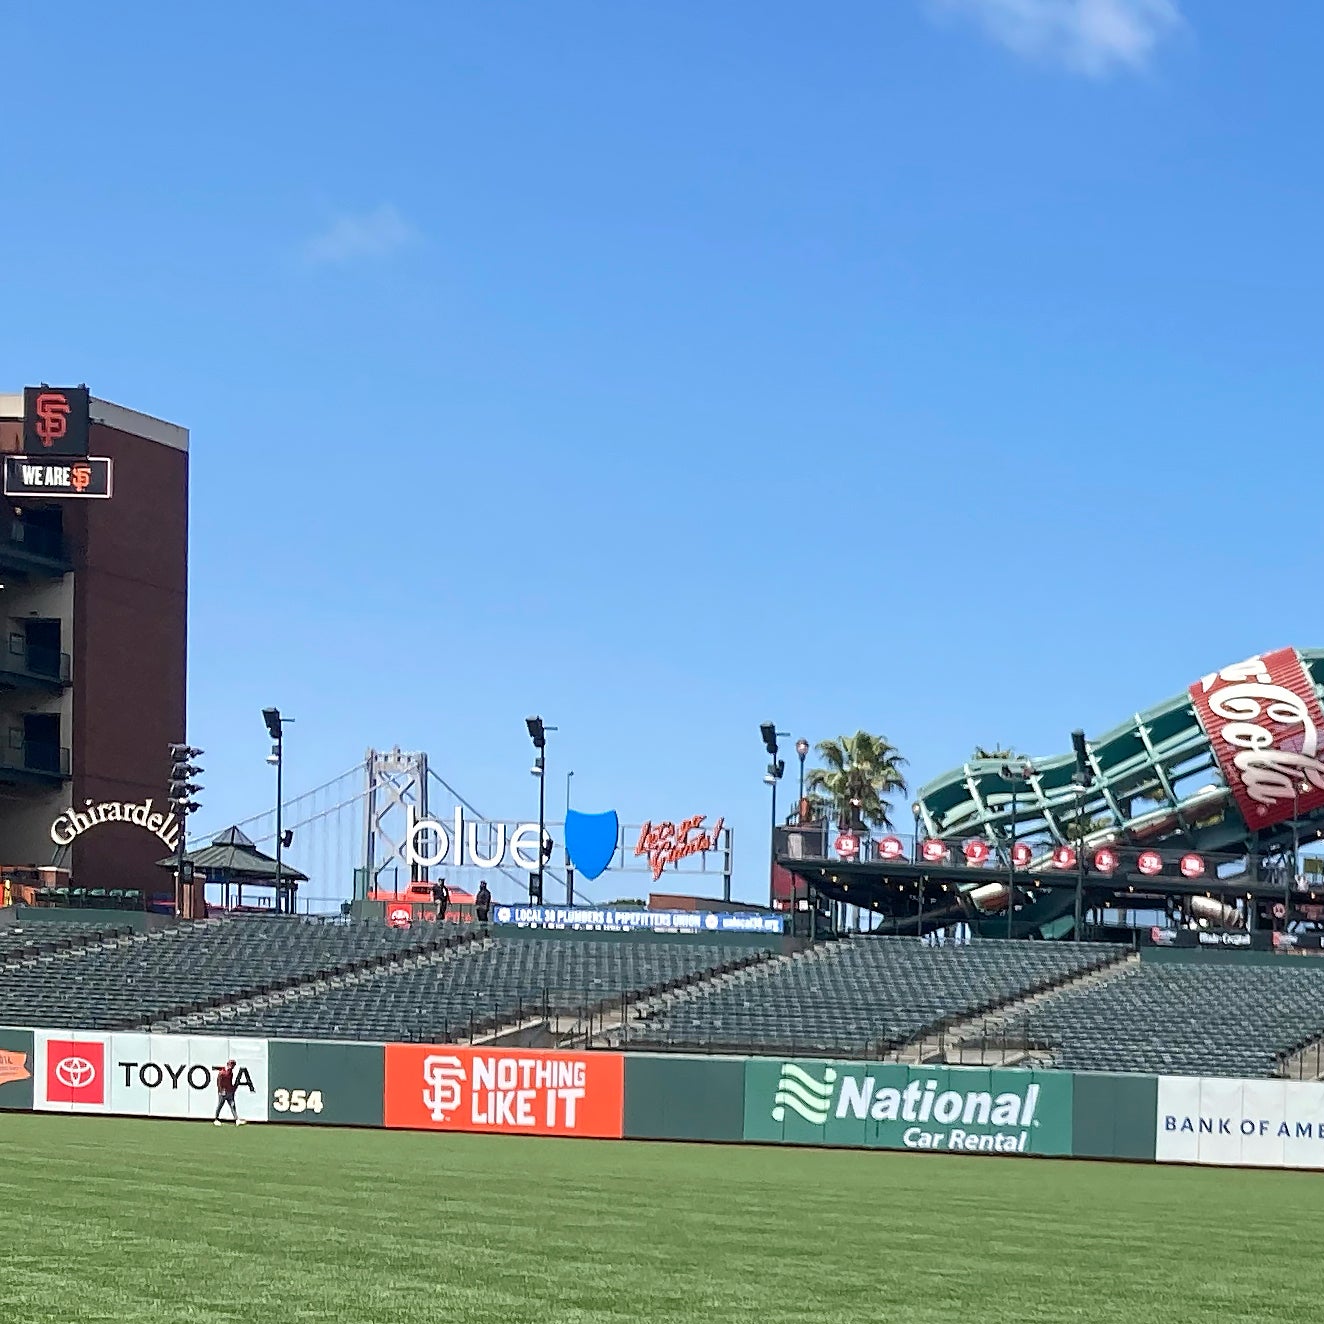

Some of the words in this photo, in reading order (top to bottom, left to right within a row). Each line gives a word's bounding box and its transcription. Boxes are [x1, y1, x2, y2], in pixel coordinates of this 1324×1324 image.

[22, 464, 44, 486] WE
[44, 465, 71, 487] ARE
[405, 804, 551, 869] blue
[515, 908, 542, 922] LOCAL
[118, 1061, 256, 1093] TOYOA
[471, 1056, 586, 1091] NOTHING
[272, 1088, 324, 1114] 354
[471, 1089, 537, 1126] LIKE
[546, 1088, 586, 1128] IT
[834, 1075, 1039, 1127] National
[903, 1127, 944, 1149] Car
[949, 1128, 1027, 1152] Rental
[1164, 1114, 1232, 1135] BANK
[1240, 1118, 1269, 1137] OF
